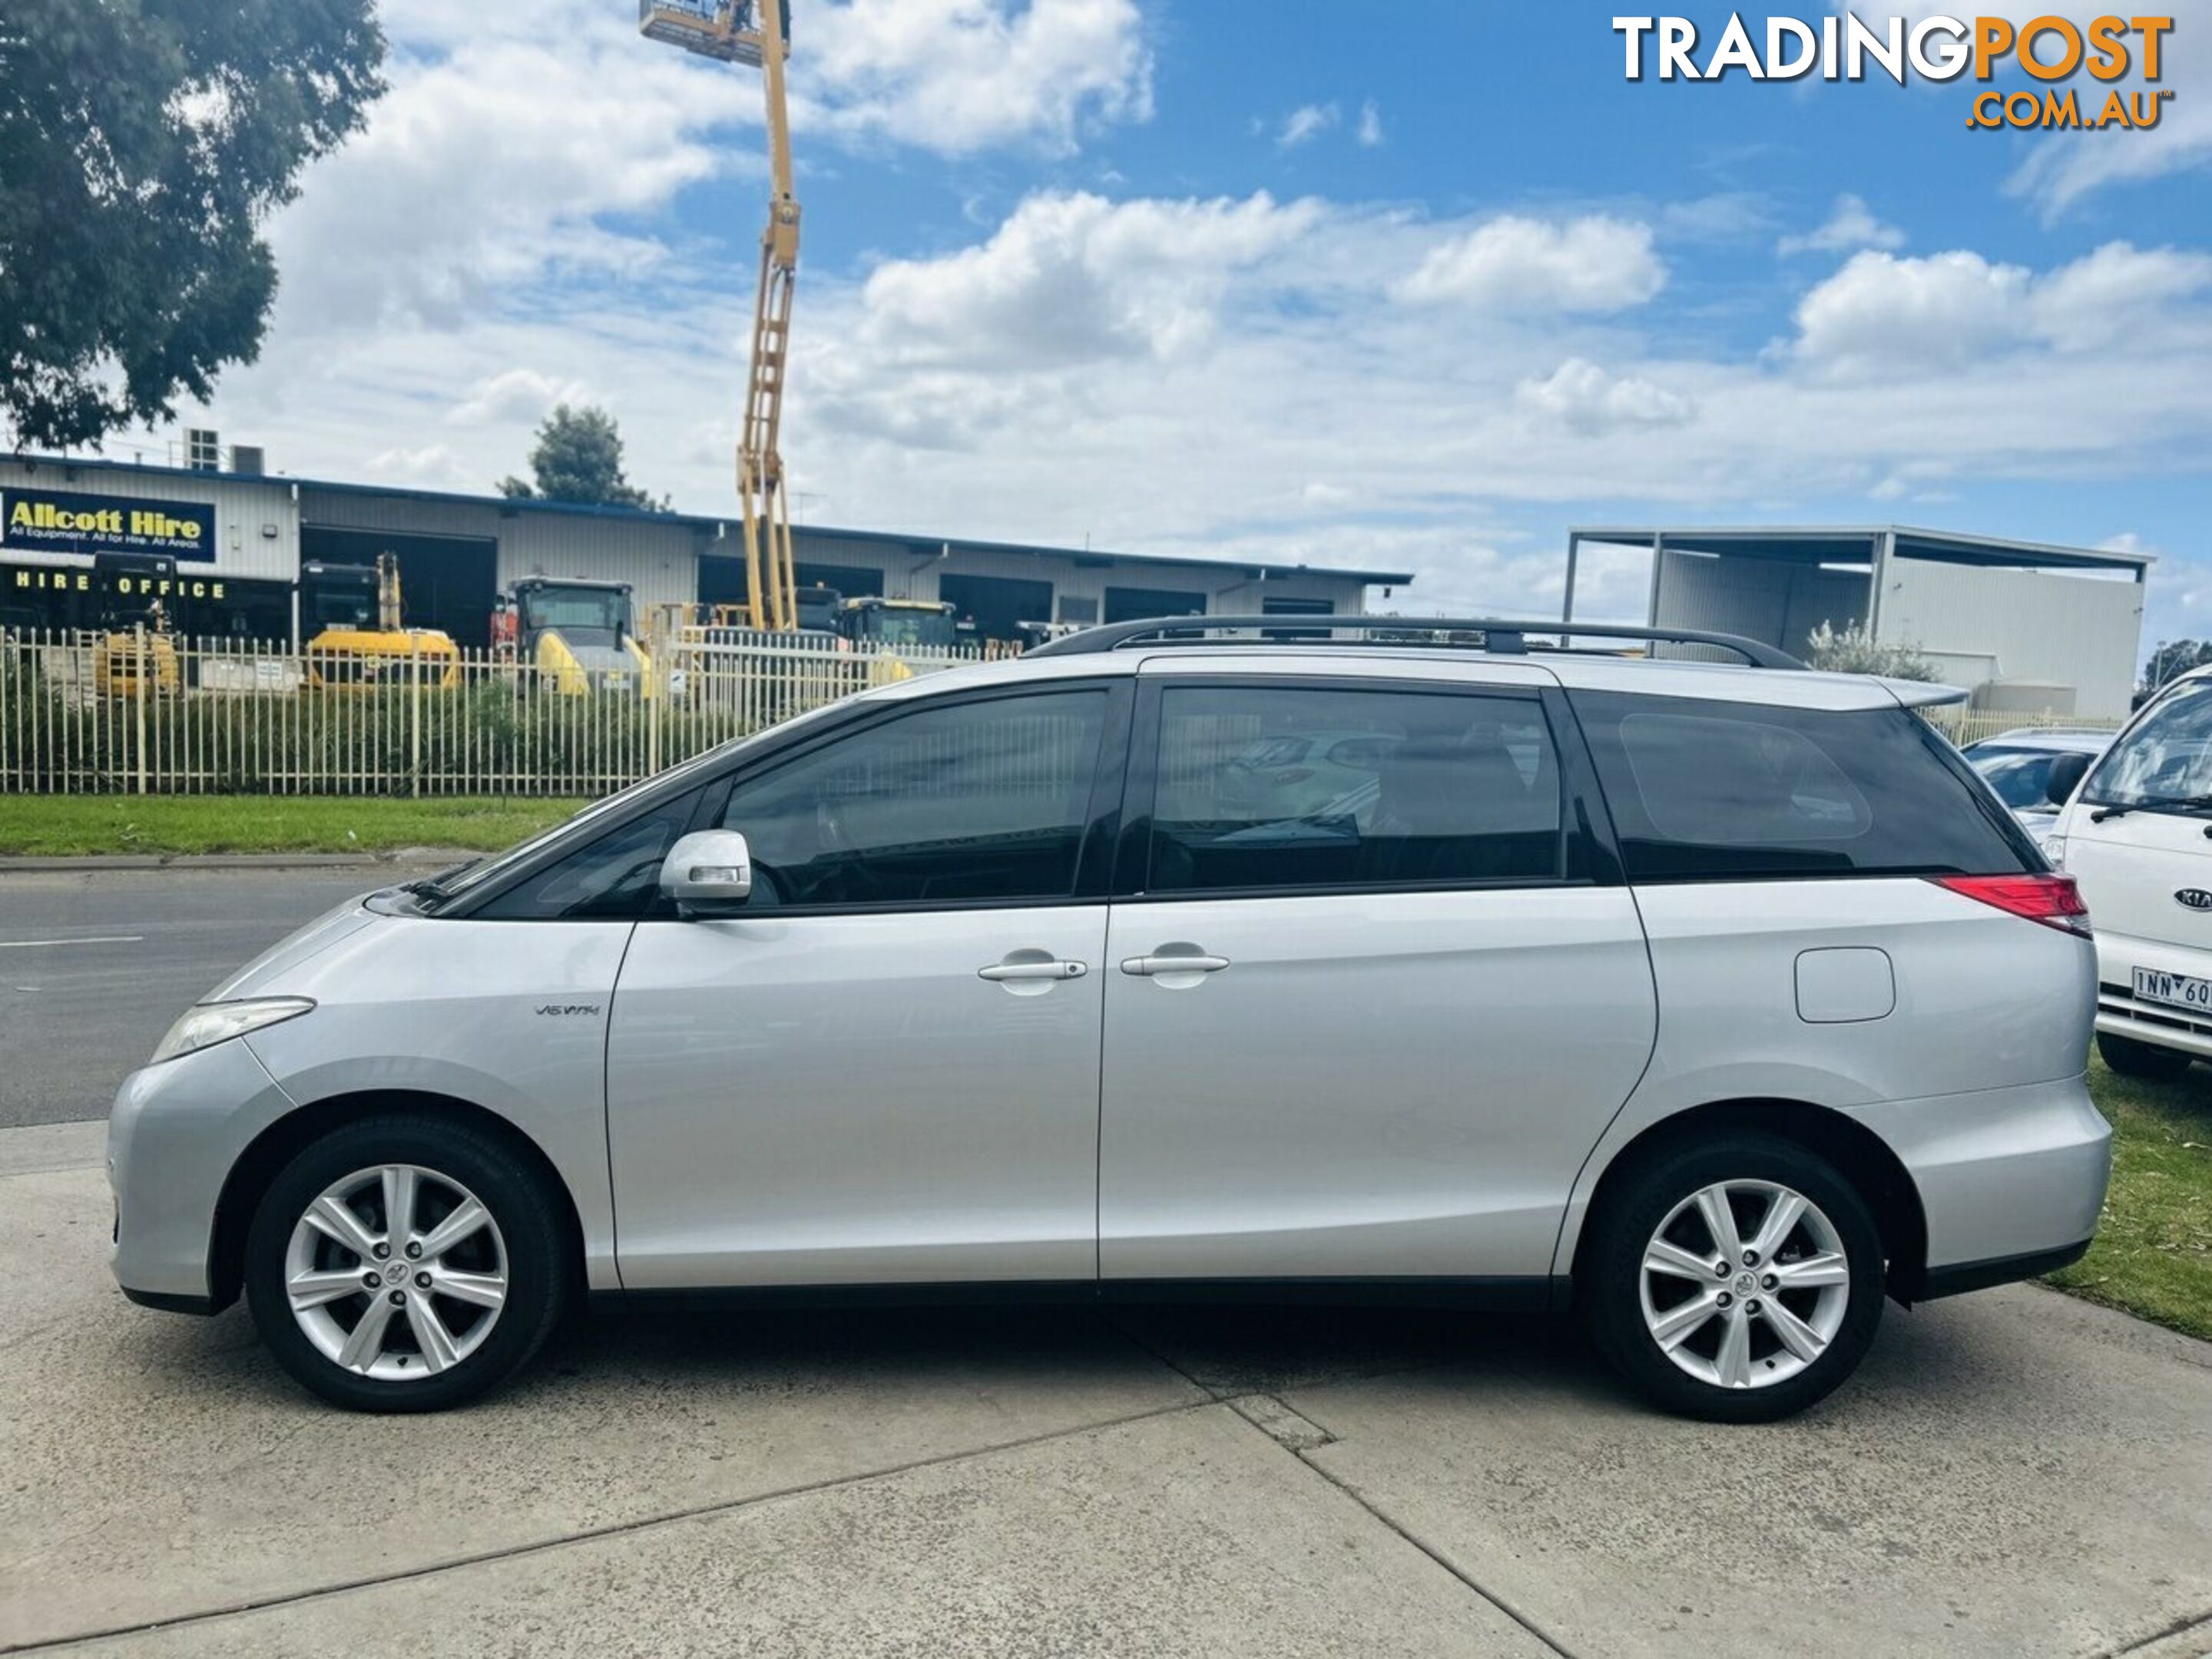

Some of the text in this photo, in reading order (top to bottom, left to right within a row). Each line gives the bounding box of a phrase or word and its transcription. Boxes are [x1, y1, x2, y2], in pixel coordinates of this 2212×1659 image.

[10, 502, 201, 538] Allcott Hire
[9, 526, 25, 535] All
[91, 531, 106, 541] All
[108, 533, 123, 544] for
[151, 536, 166, 546] All
[16, 571, 224, 598] HIRE OFFICE
[2182, 891, 2212, 906] KIA
[2138, 972, 2171, 997] 1NN
[2185, 982, 2212, 1005] 6Q
